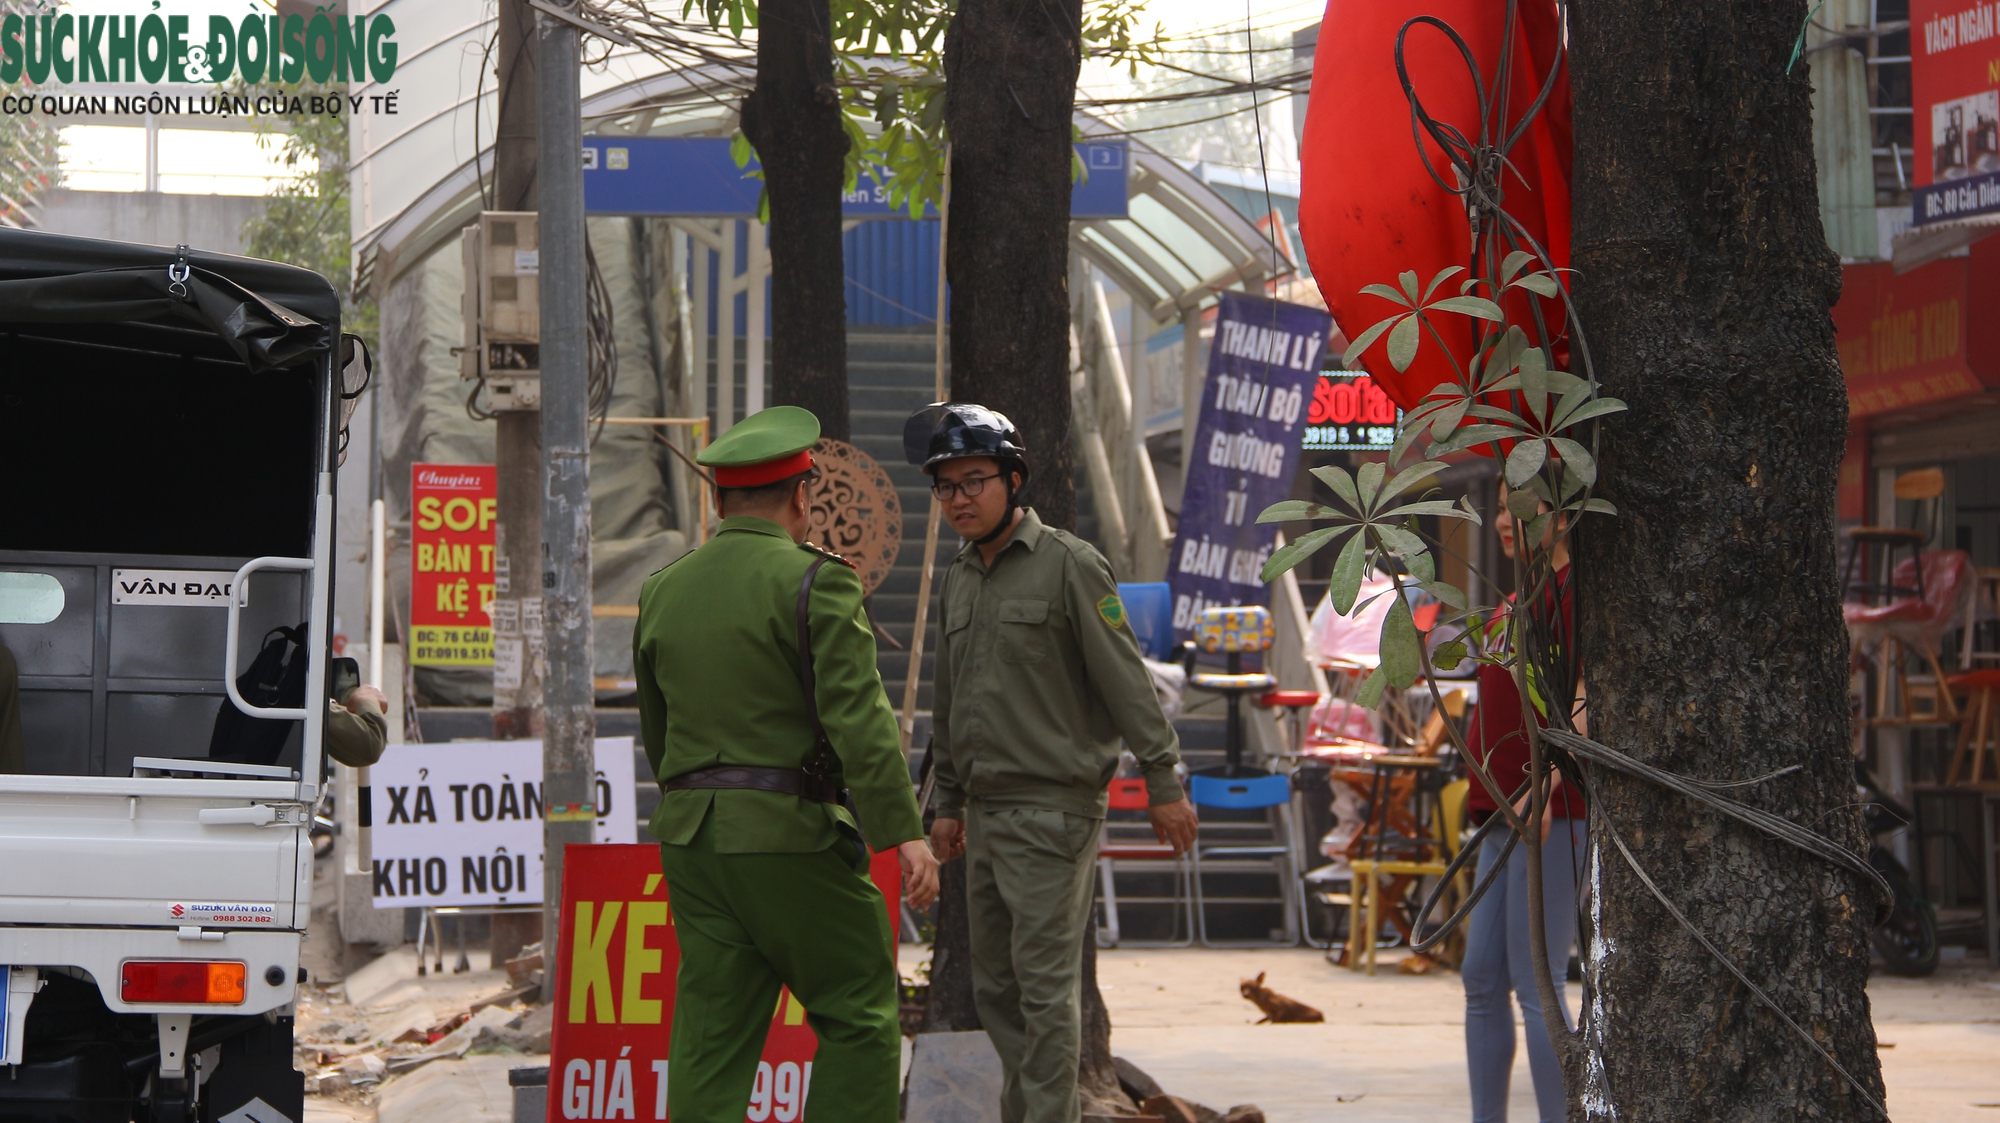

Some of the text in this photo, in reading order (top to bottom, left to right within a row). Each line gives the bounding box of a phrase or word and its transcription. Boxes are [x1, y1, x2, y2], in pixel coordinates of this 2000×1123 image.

[1924, 12, 1957, 55] VÁCH
[1958, 1, 1994, 46] NGĂN
[1944, 189, 1958, 213] 80
[1221, 319, 1322, 372] THANH LÝ
[1215, 373, 1302, 432] TOÀN BỘ
[1208, 428, 1285, 479] GIƯỜNG
[418, 471, 480, 488] Chuyên:
[418, 538, 471, 572] BÀN
[1179, 533, 1228, 580] BÀN
[120, 577, 176, 595] VÂN
[437, 578, 470, 618] KỆ
[387, 768, 612, 826] XẢ TOÀN Ộ
[373, 846, 526, 902] KHO NỘI
[191, 904, 272, 914] SUZUKI VÂN ĐẠO
[237, 915, 253, 923] 302
[568, 873, 675, 1024] KÉ
[562, 1046, 635, 1120] GIÁ
